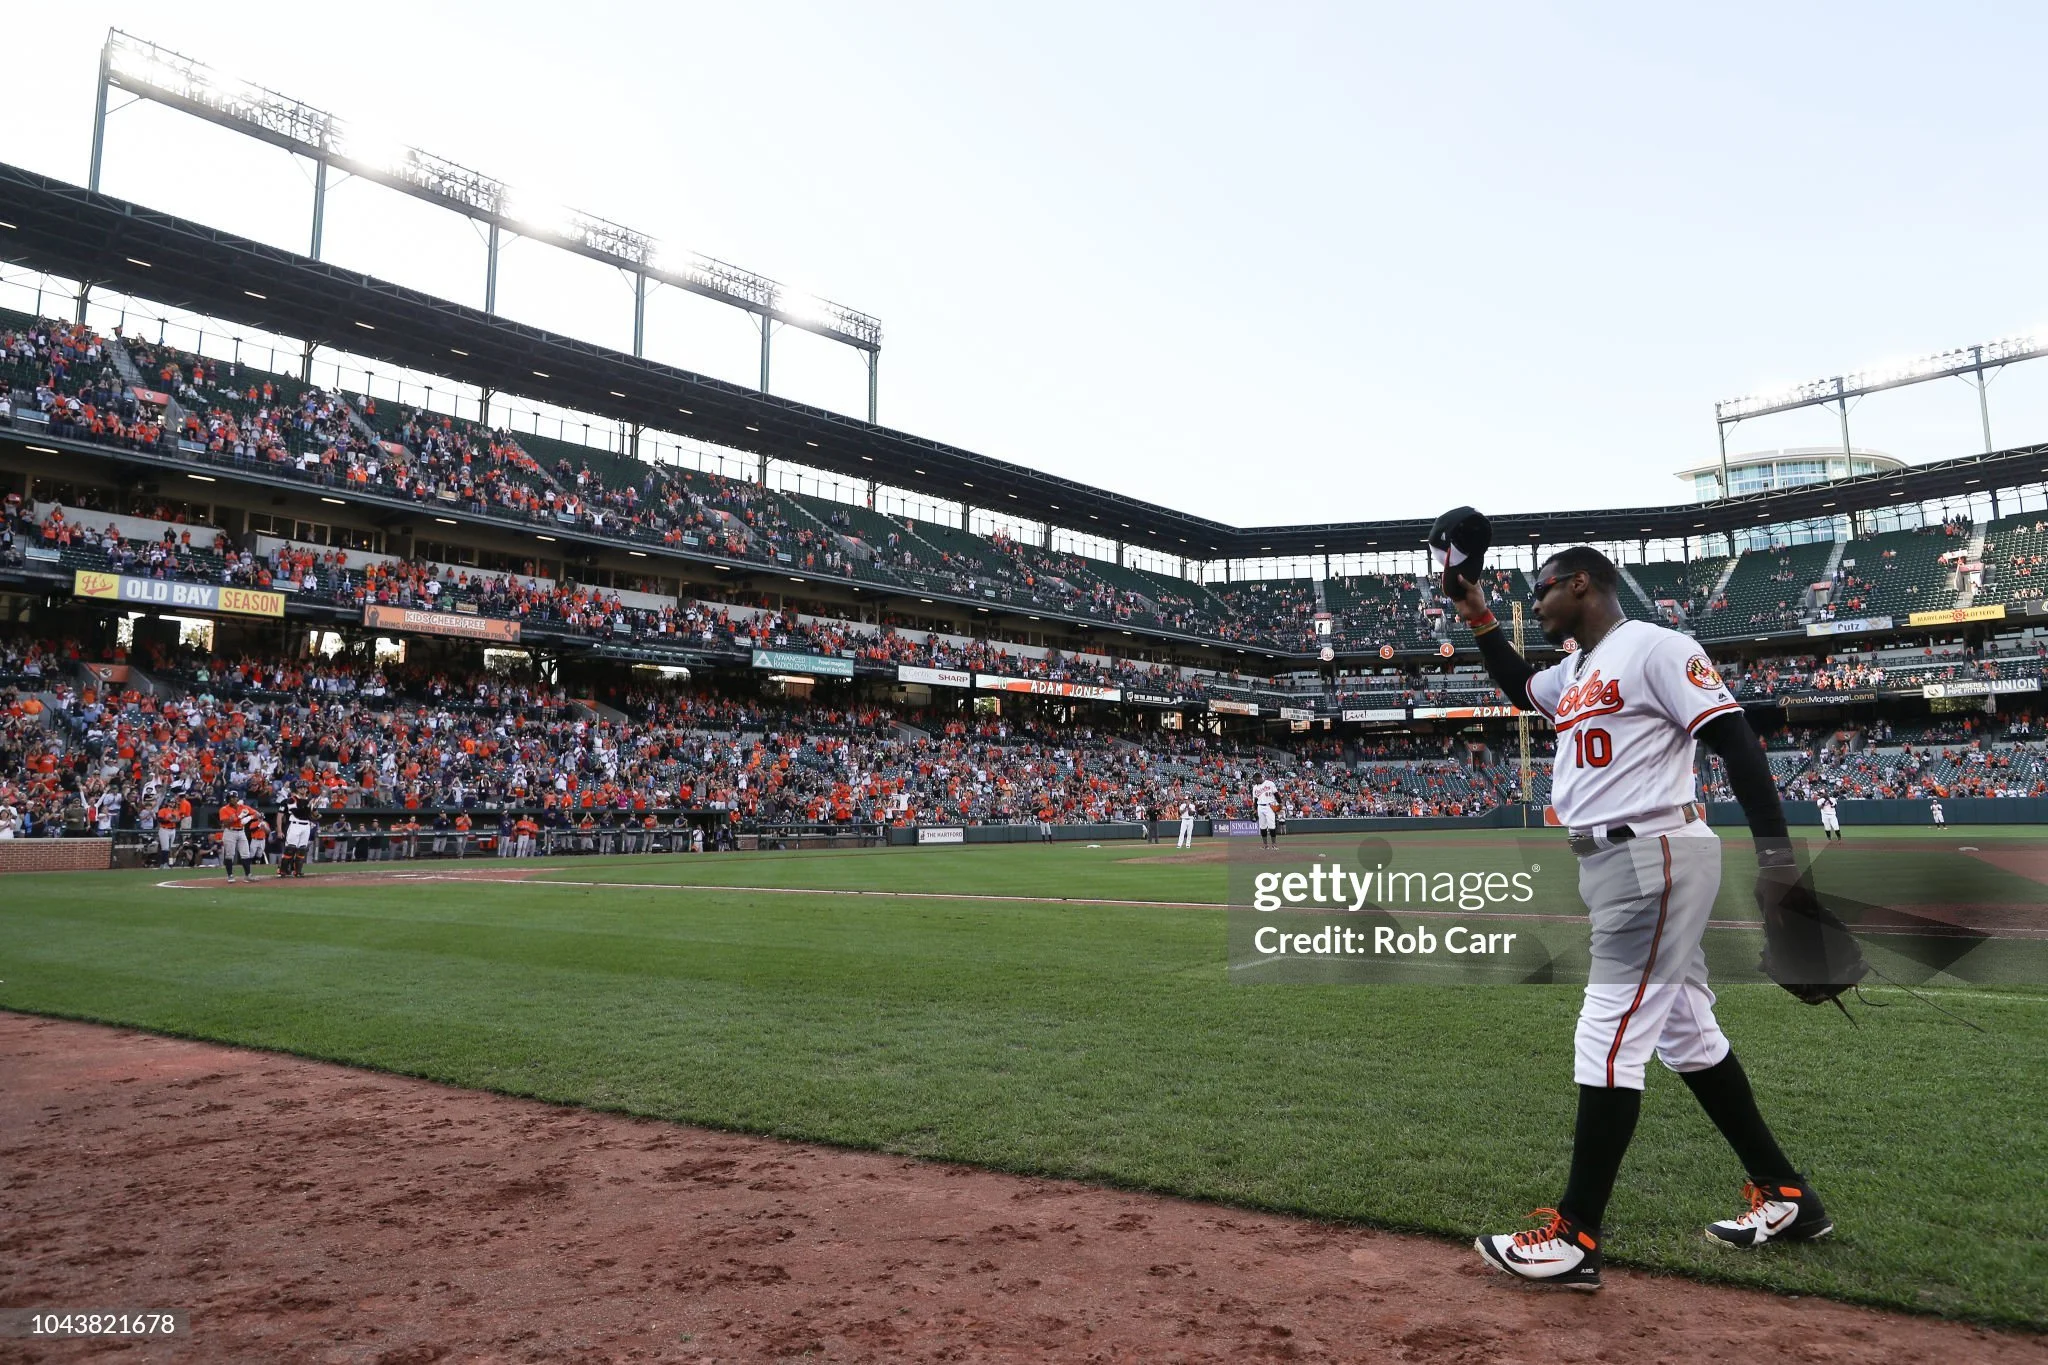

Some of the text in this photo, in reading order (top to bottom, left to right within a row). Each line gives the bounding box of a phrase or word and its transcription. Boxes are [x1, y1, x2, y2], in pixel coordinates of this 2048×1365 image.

[82, 575, 280, 613] It's OLD BAY SEASON
[405, 611, 486, 630] KIDS CHEER FREE
[1384, 648, 1390, 656] 5
[1443, 646, 1450, 655] 4
[1565, 642, 1576, 650] 33
[773, 659, 808, 671] RADIOLOGY
[938, 673, 968, 683] SHARP
[1030, 680, 1063, 696] ADAM
[1069, 684, 1104, 699] JONES
[1991, 678, 2038, 691] UNION
[1472, 706, 1511, 717] ADAM
[1575, 728, 1612, 768] 10
